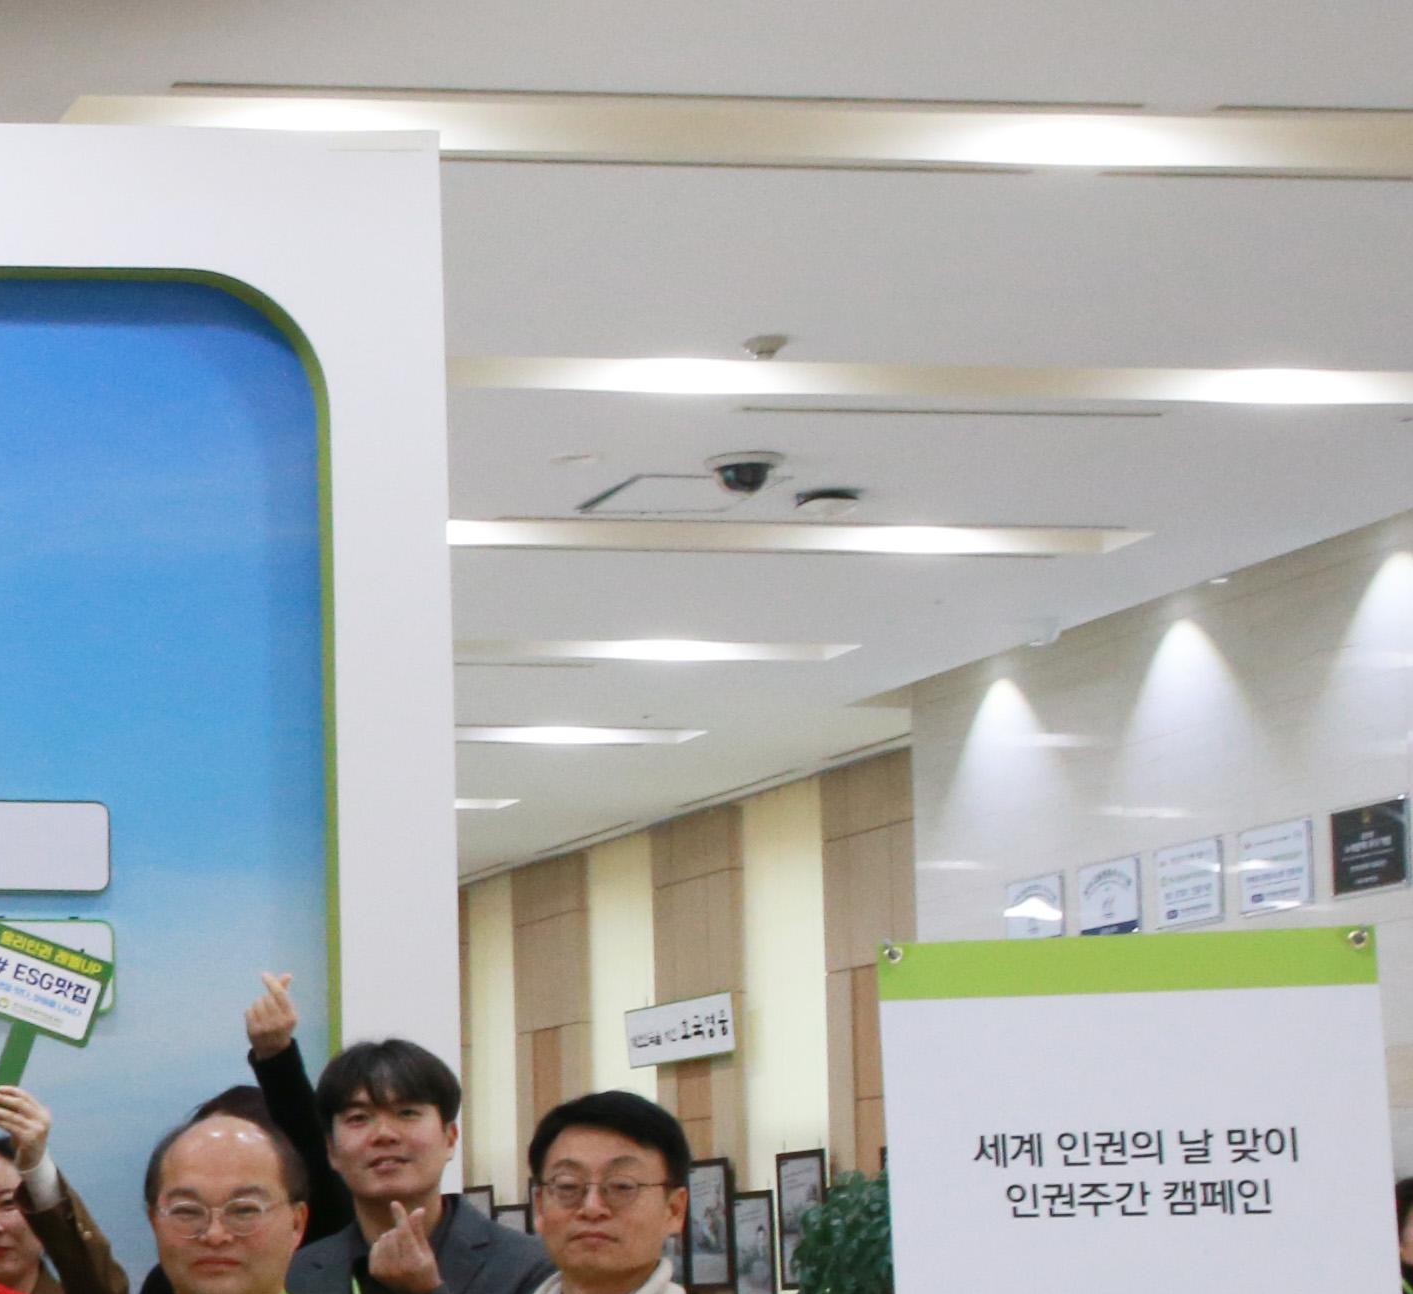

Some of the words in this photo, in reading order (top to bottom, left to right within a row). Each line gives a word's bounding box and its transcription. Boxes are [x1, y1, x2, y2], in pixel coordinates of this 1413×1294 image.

[13, 963, 92, 1004] ESG맛집
[973, 1132, 1043, 1168] 세계
[1056, 1129, 1164, 1167] 인권의
[1179, 1128, 1213, 1163] 날
[1226, 1126, 1299, 1162] 맞이
[1006, 1180, 1150, 1218] 인권주간
[1162, 1179, 1272, 1216] 캠페인
